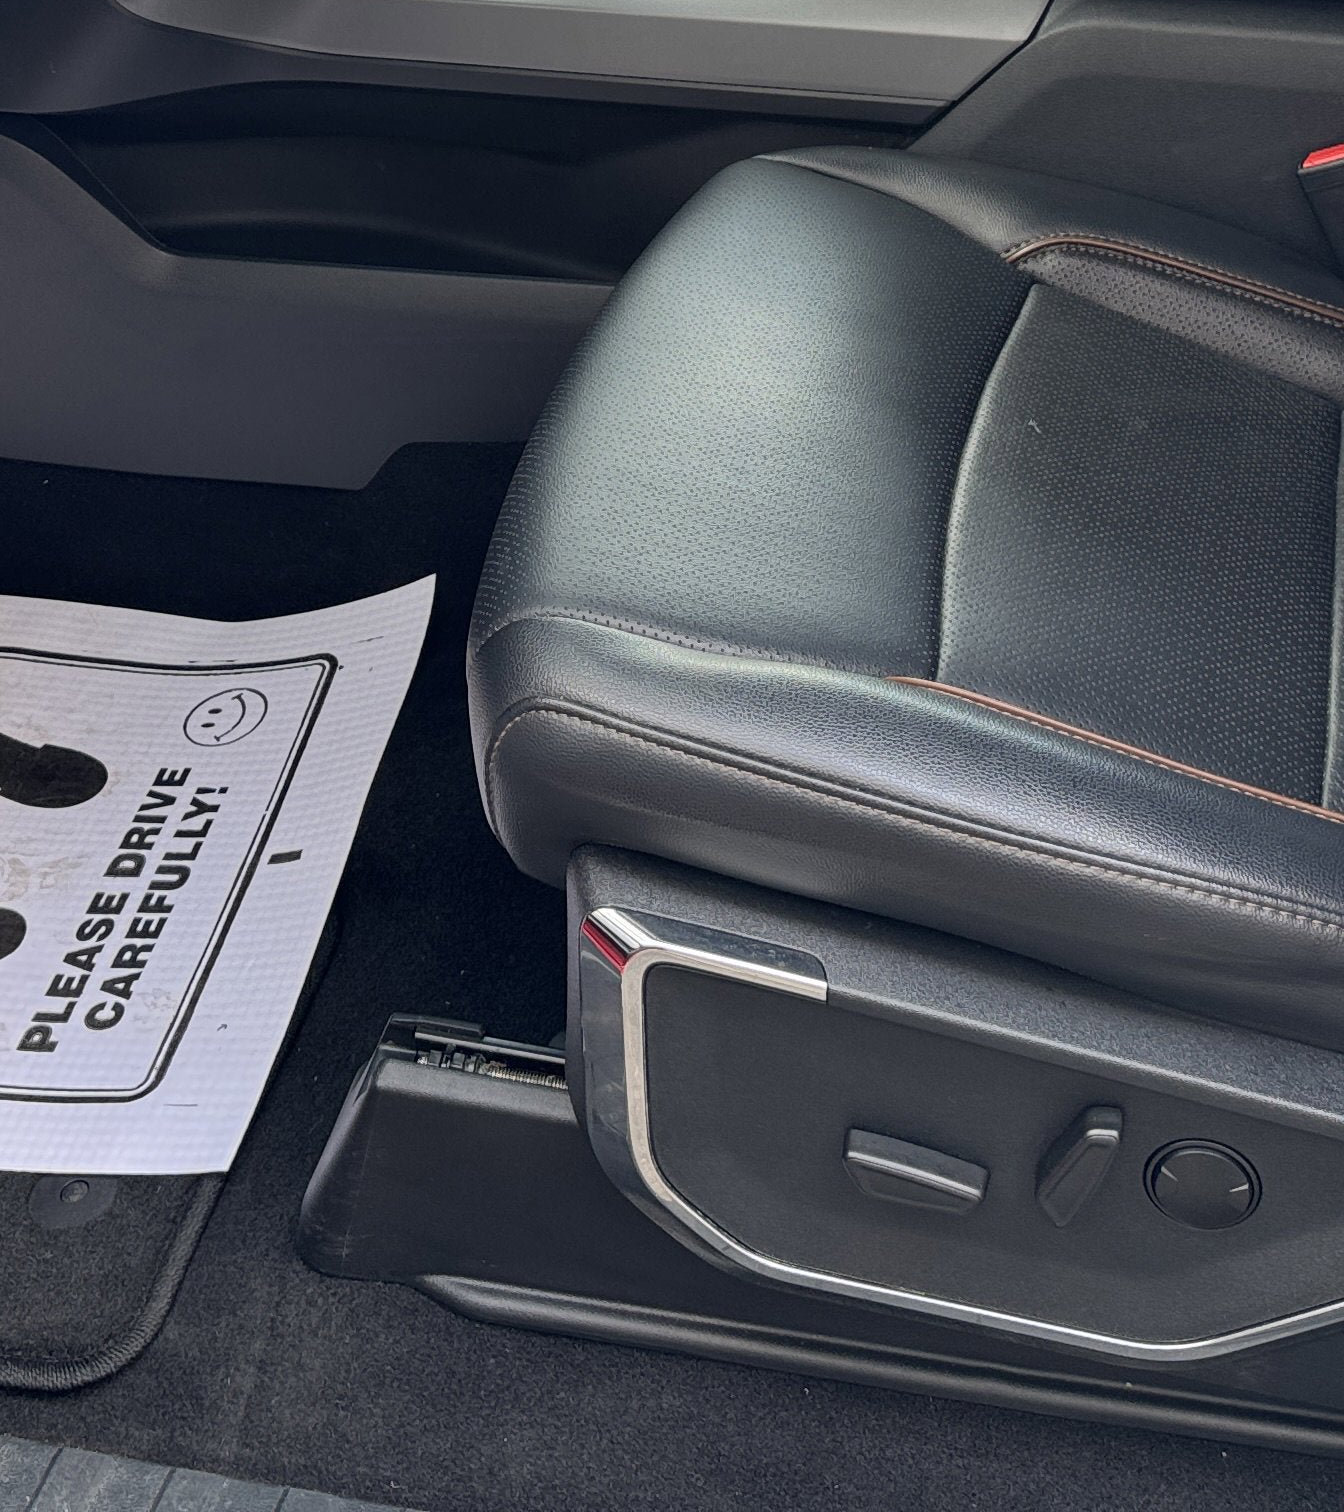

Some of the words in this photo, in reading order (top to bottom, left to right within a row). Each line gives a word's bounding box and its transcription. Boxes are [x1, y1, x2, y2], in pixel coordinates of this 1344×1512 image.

[16, 891, 131, 1053] PLEASE
[102, 767, 192, 879] DRIVE
[84, 785, 229, 1031] CAREFULLY!
